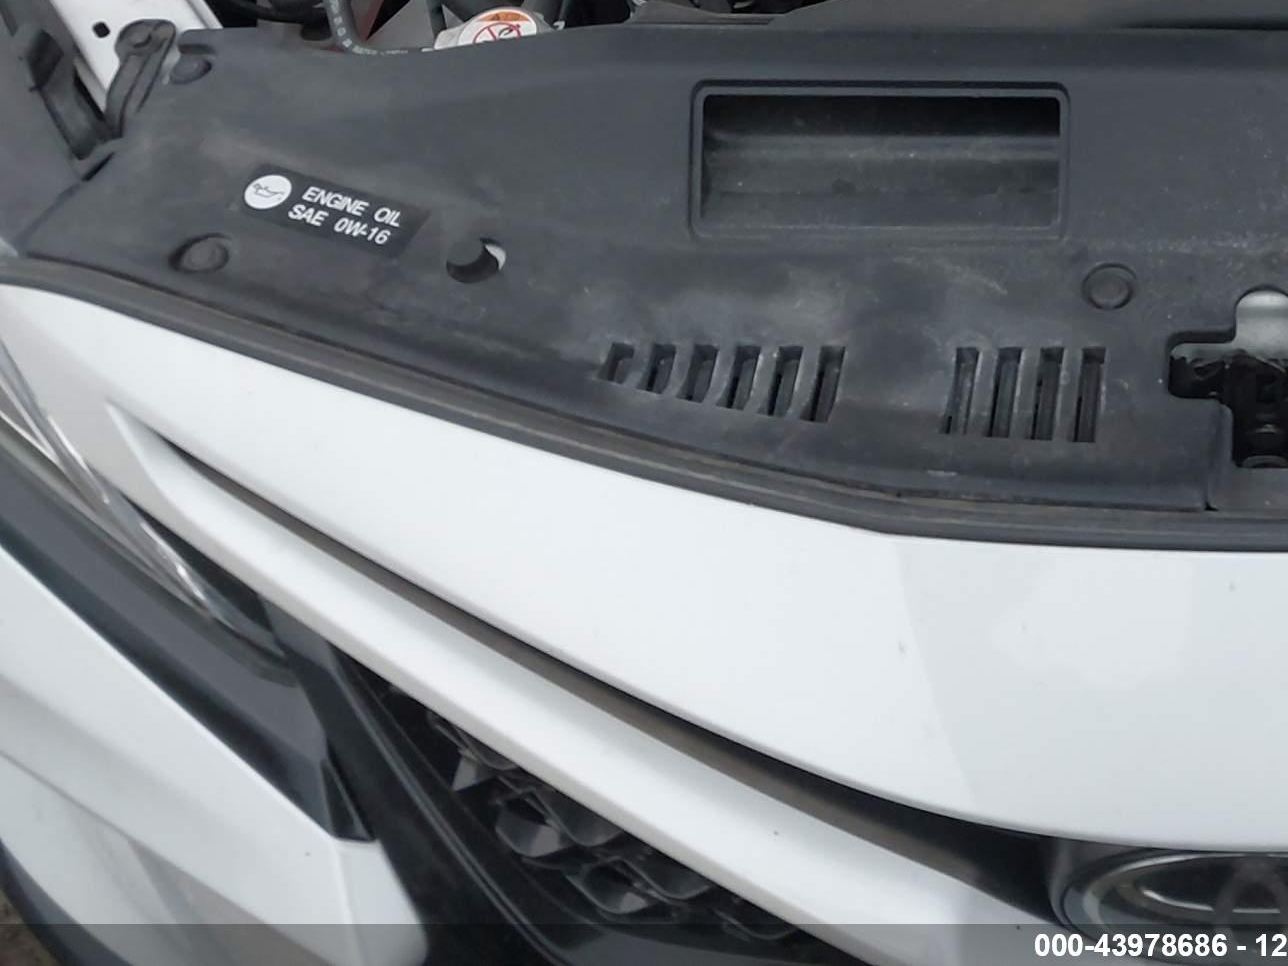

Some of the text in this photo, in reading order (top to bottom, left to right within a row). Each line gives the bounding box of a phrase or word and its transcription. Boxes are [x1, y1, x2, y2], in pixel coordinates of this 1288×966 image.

[288, 204, 391, 245] SAE 0W-16
[302, 186, 401, 227] ENGINE OIL
